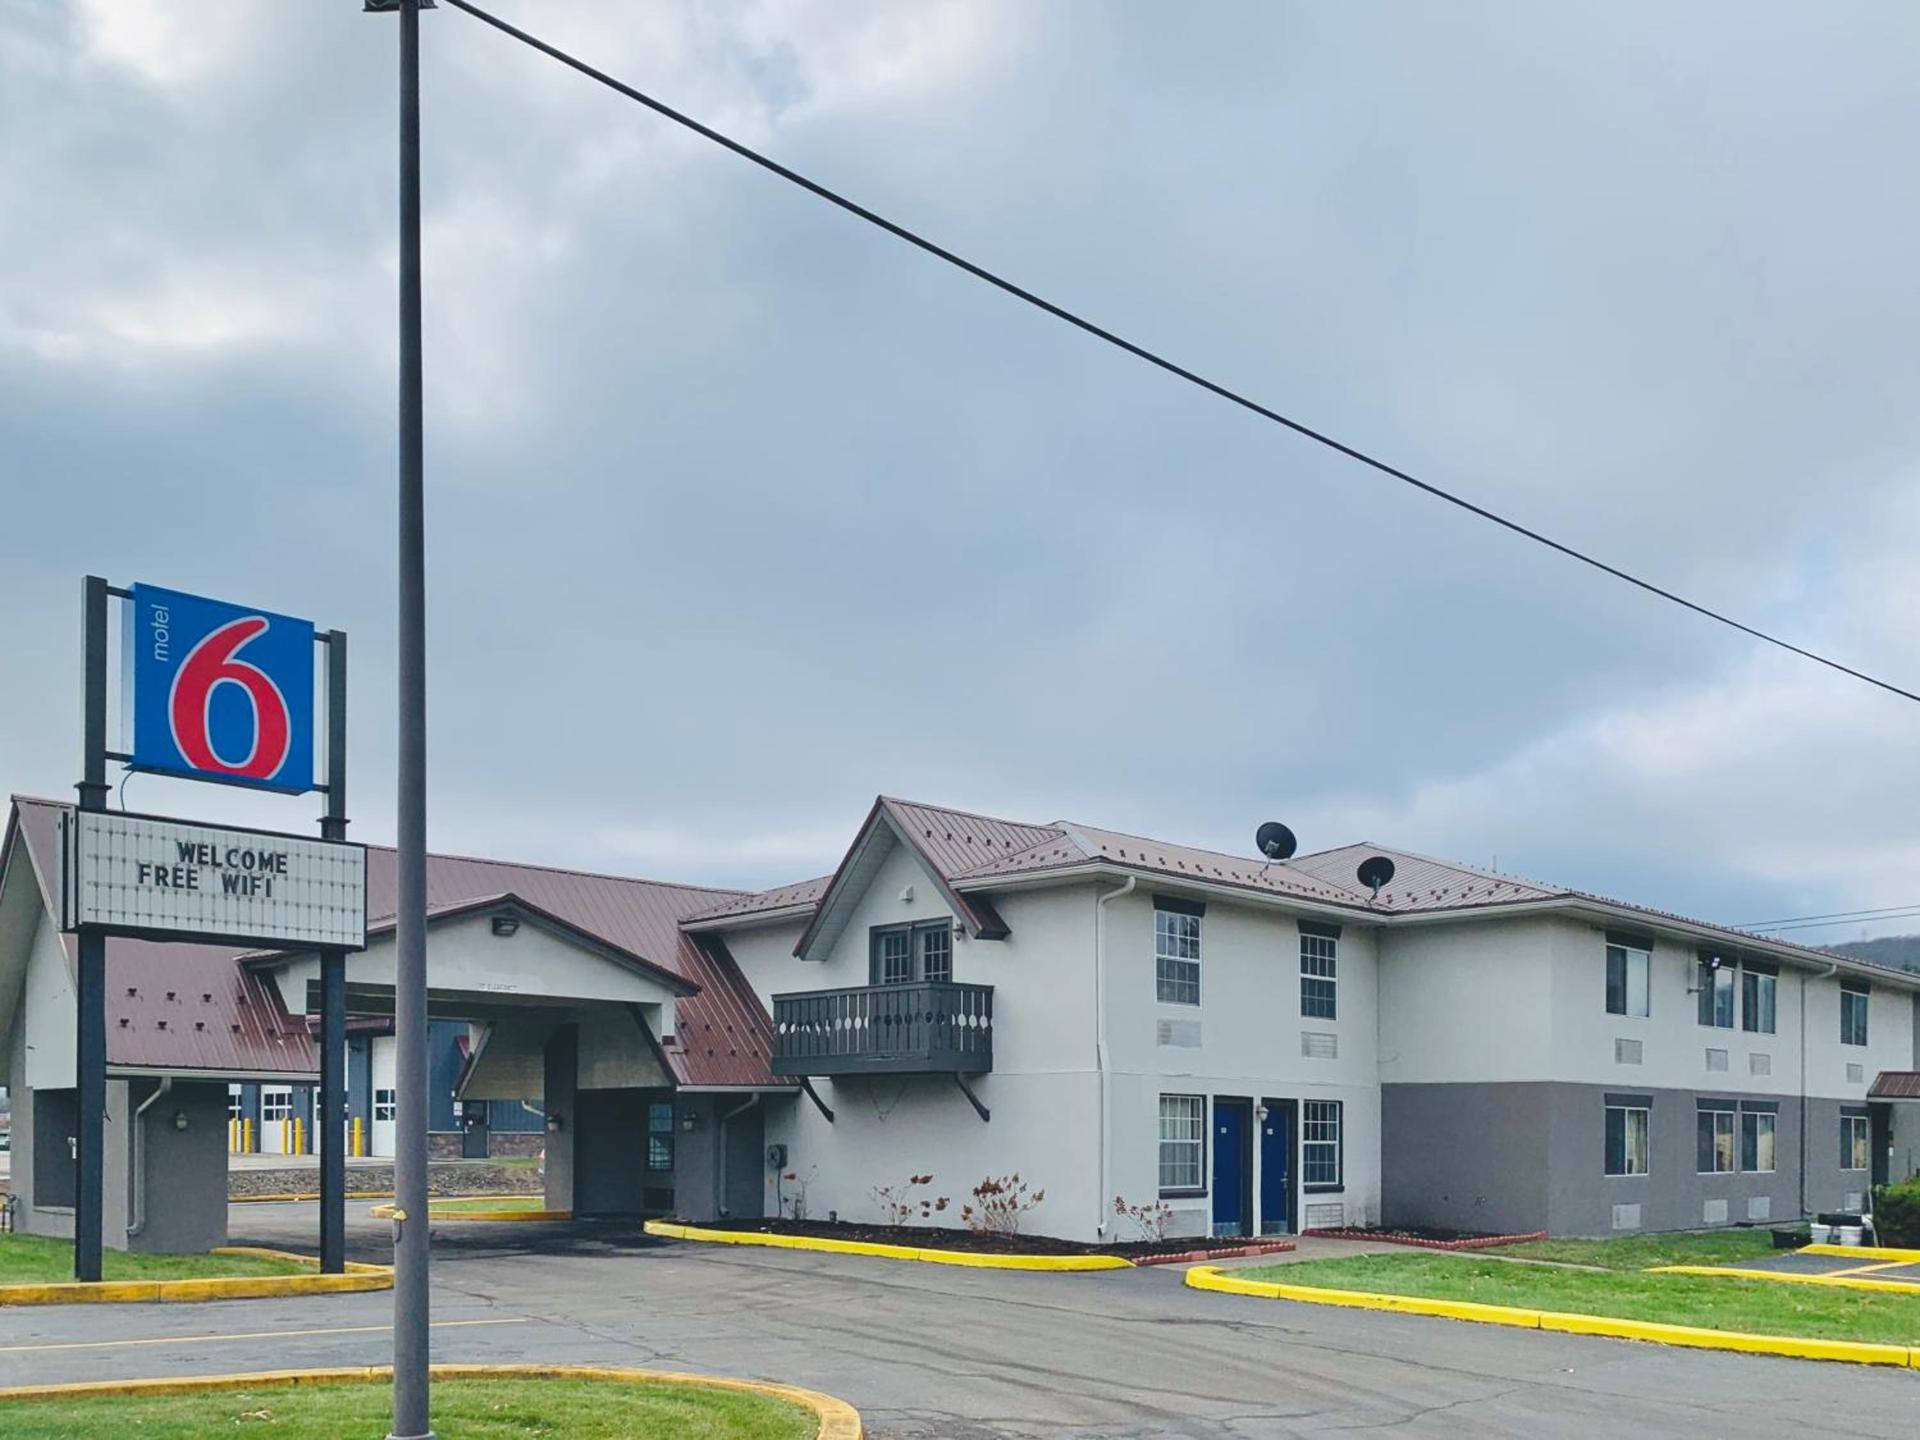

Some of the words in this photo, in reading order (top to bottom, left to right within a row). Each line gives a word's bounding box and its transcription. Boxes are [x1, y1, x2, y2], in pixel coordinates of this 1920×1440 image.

[153, 603, 169, 662] motel
[169, 616, 291, 780] 6
[137, 863, 199, 891] FREE
[221, 872, 273, 898] WIFI
[177, 841, 288, 874] WELCOME
